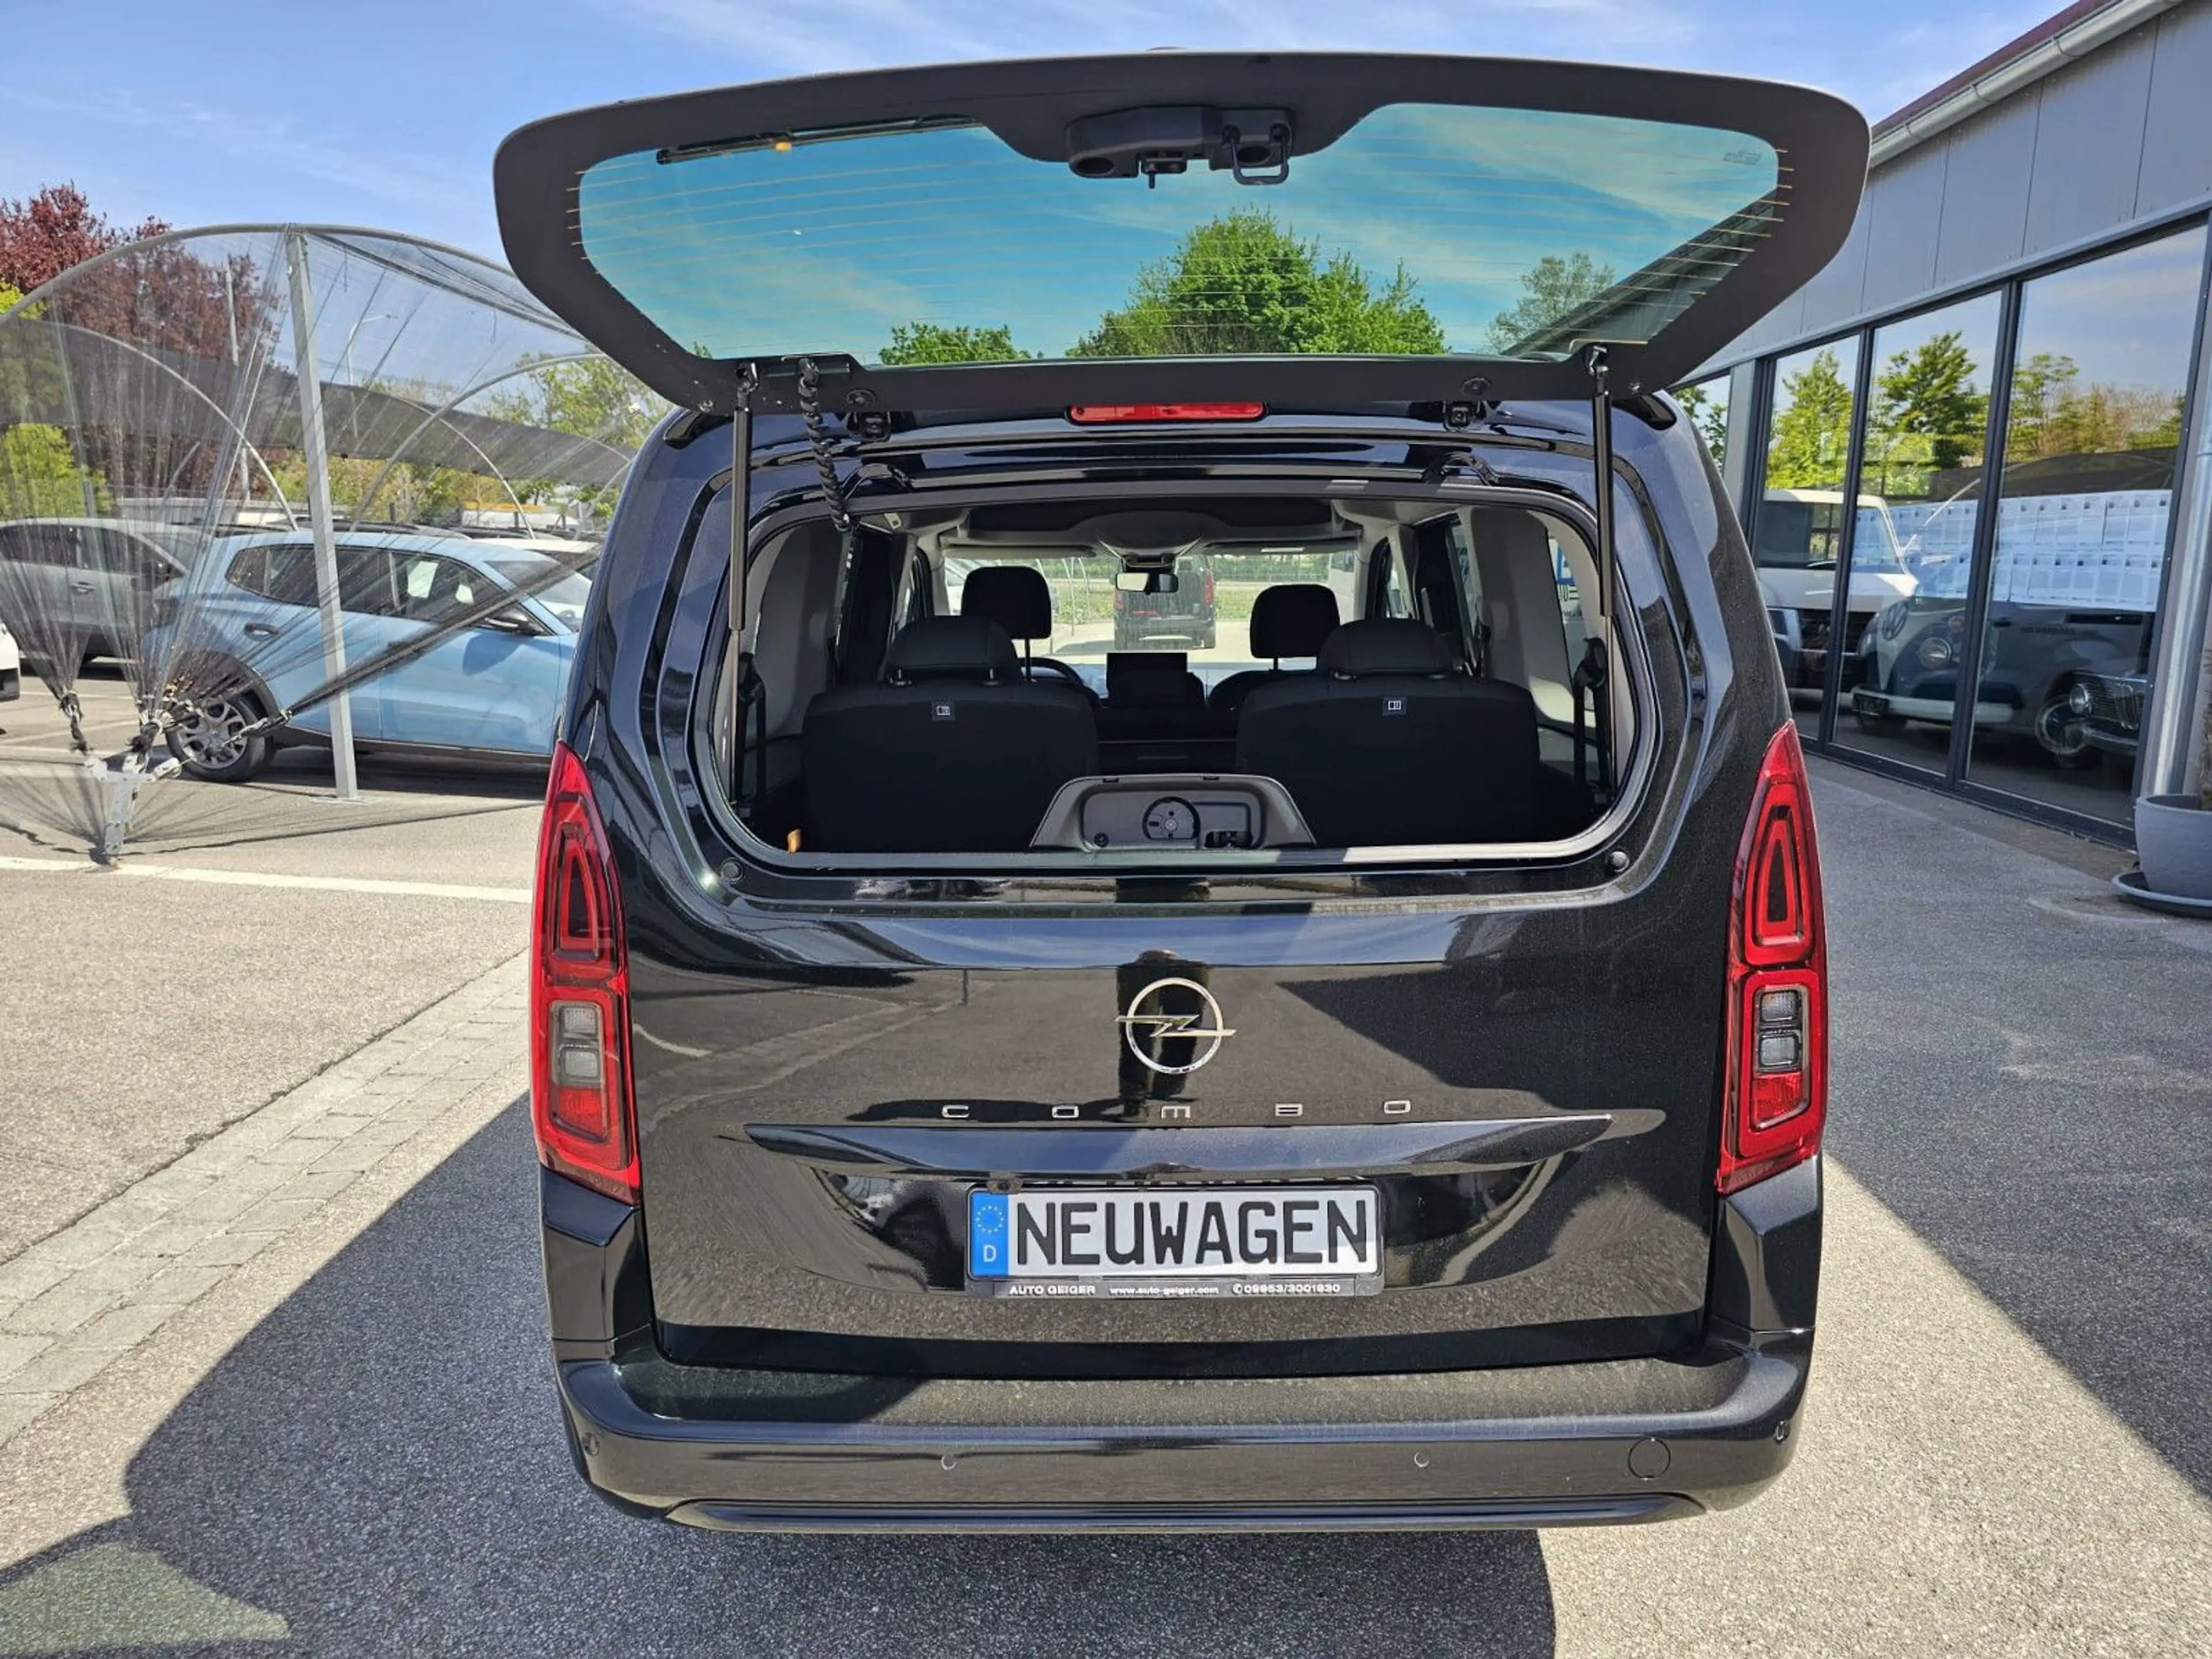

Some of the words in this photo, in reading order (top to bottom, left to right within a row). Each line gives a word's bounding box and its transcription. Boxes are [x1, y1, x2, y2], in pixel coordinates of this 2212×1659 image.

[942, 1100, 1411, 1119] COMBO
[1017, 1200, 1367, 1264] NEUWAGEN
[984, 1244, 996, 1262] D
[1009, 1285, 1044, 1295] AUTO
[1047, 1285, 1095, 1295] GEIGER
[1109, 1286, 1218, 1296] www.auto-geiger.com
